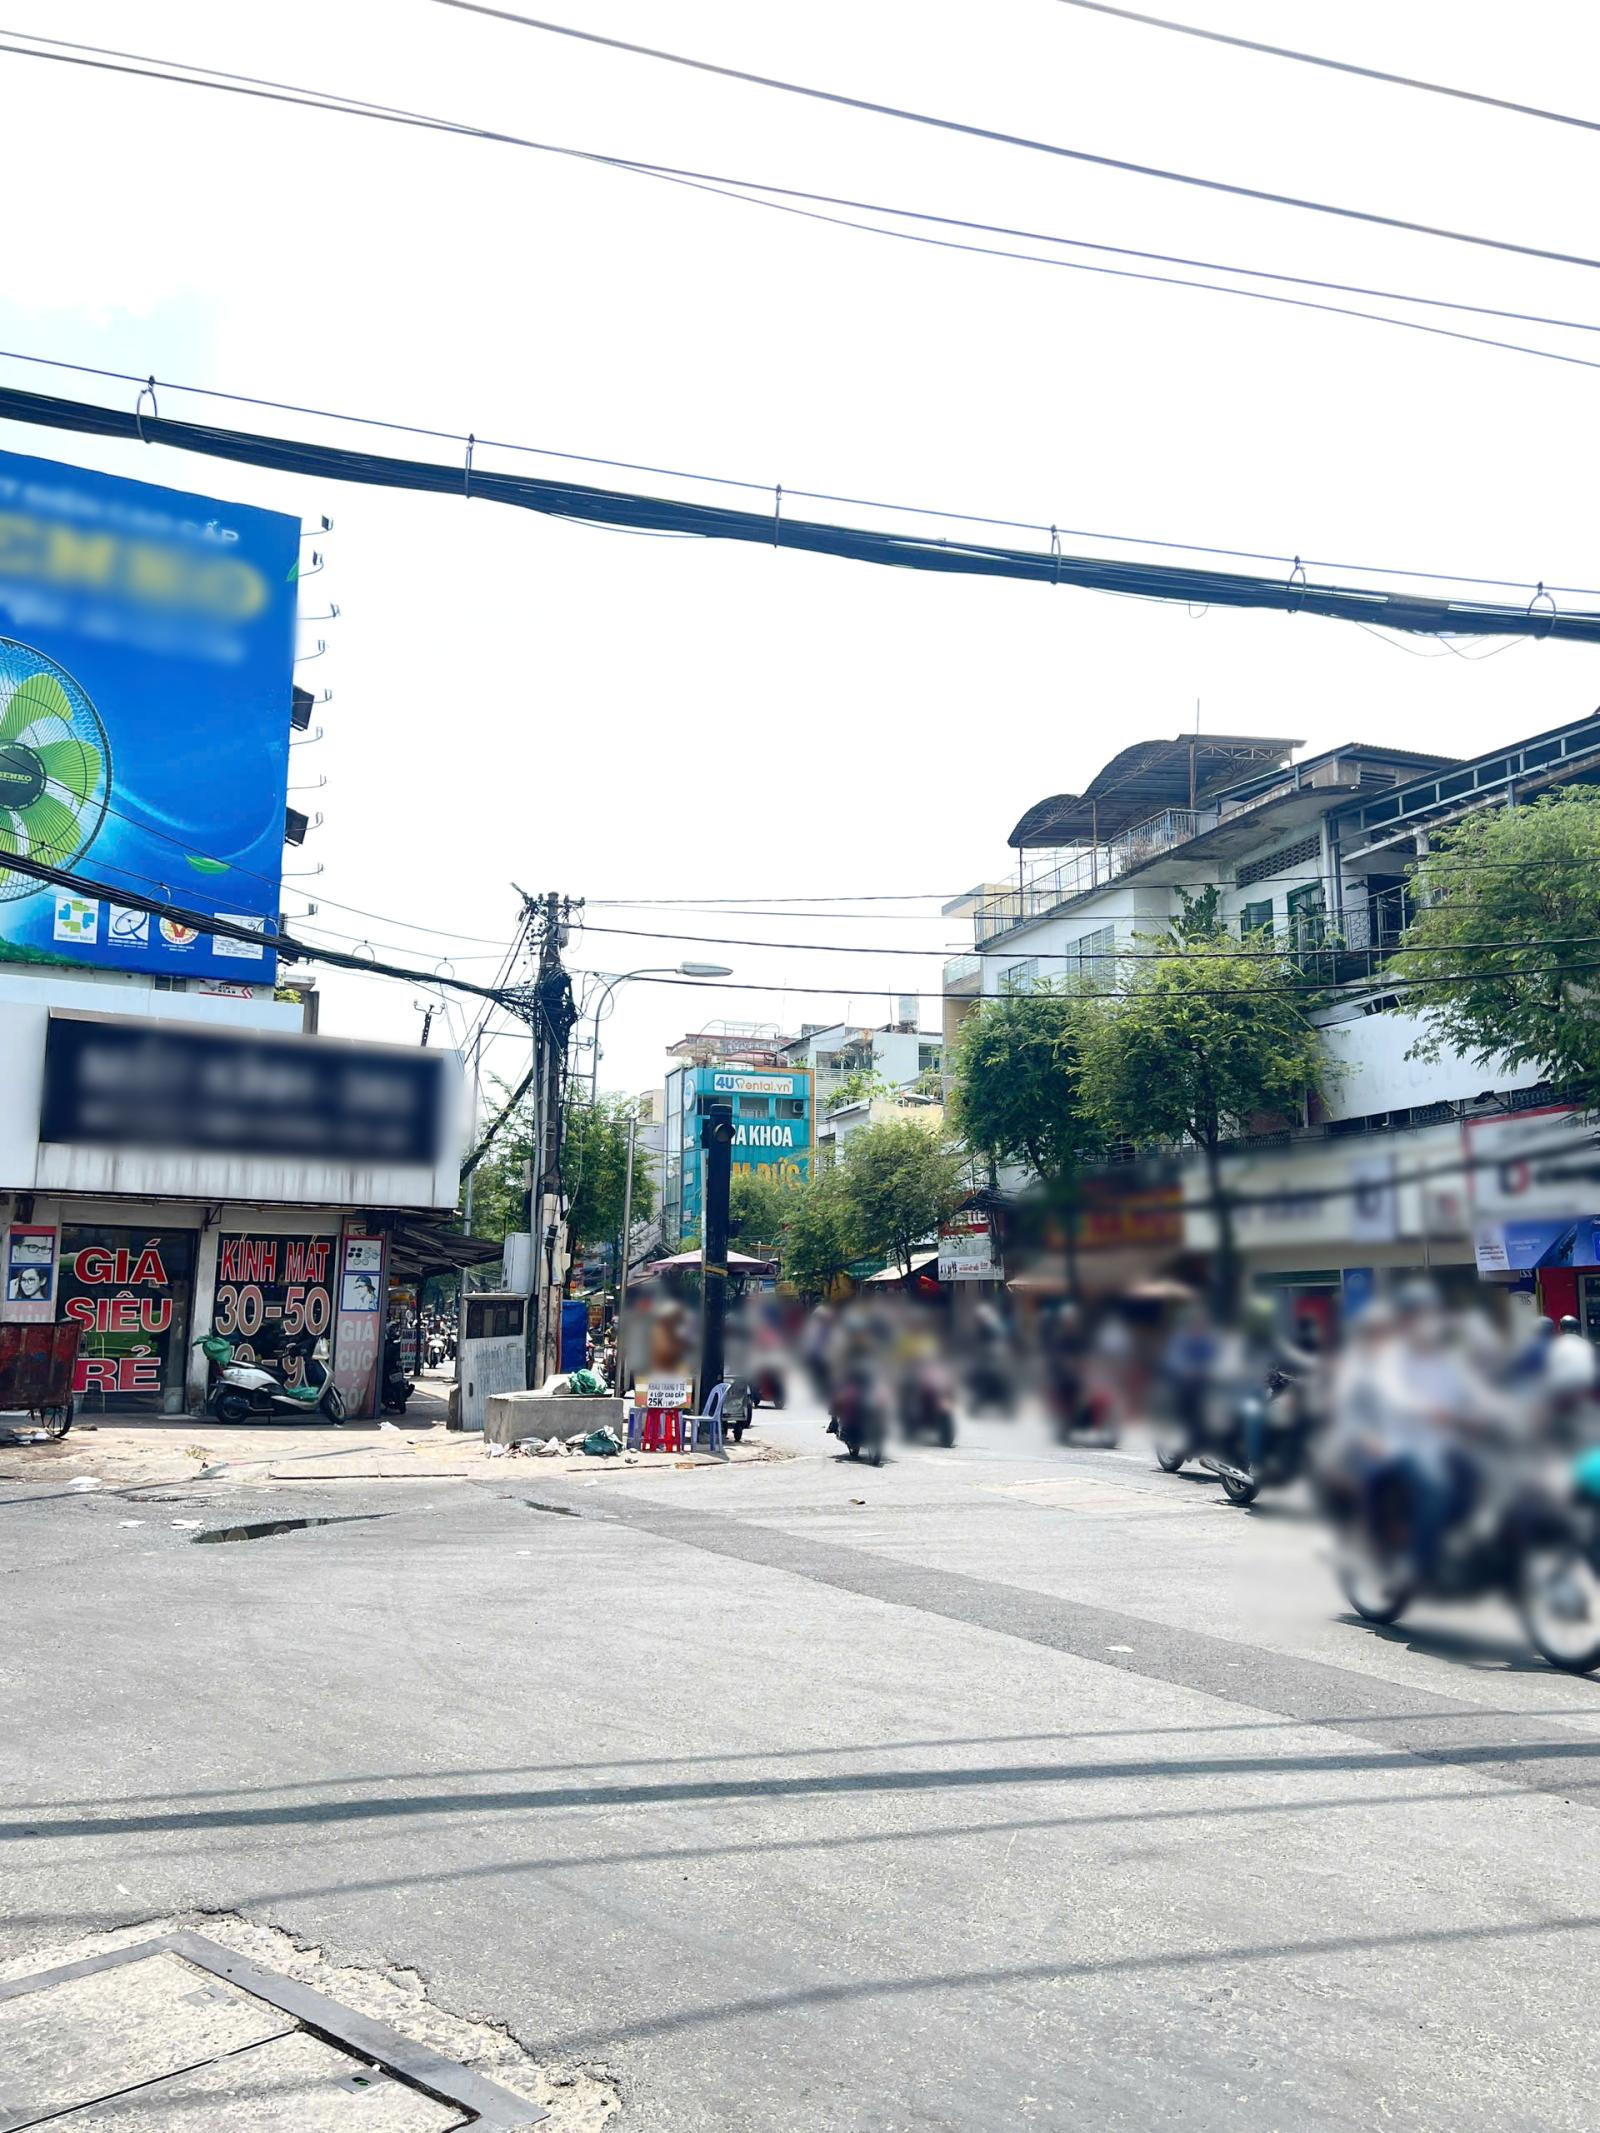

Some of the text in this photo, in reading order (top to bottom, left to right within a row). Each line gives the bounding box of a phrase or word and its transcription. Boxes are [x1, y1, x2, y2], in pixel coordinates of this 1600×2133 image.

[749, 1125, 793, 1147] KHOA
[74, 1238, 168, 1284] GIÁ
[220, 1233, 331, 1282] KÍNH MÁT
[65, 1291, 173, 1333] SIÊU
[215, 1284, 331, 1337] 30-50
[341, 1314, 374, 1341] GIÁ
[72, 1345, 161, 1393] RẺ
[648, 1398, 663, 1407] 25K
